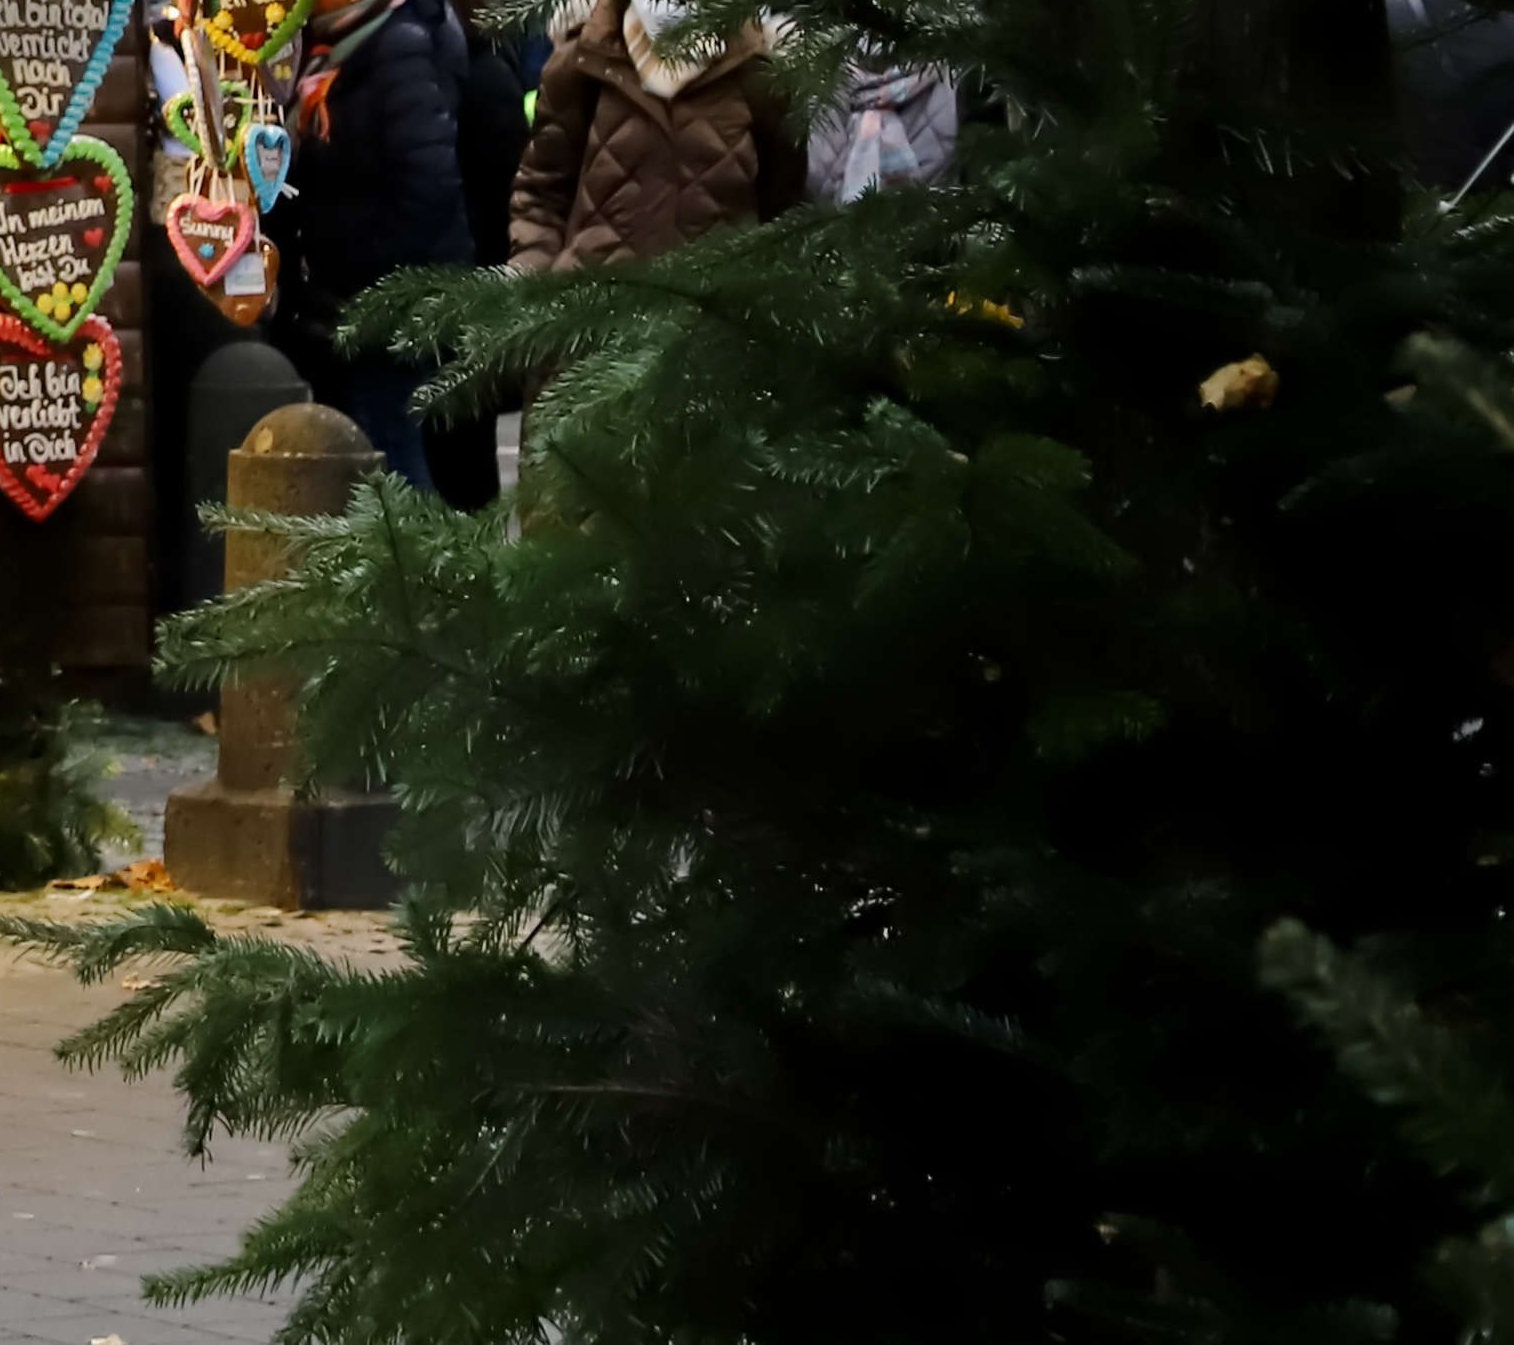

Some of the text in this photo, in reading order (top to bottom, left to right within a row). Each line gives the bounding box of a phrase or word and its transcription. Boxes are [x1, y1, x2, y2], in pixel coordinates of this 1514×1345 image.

[13, 51, 73, 87] nach
[17, 85, 64, 120] Dir
[28, 196, 106, 229] meinem
[180, 215, 235, 247] Sunny
[17, 255, 92, 293] bist Du
[45, 361, 81, 400] bin
[3, 429, 78, 465] in Dich
